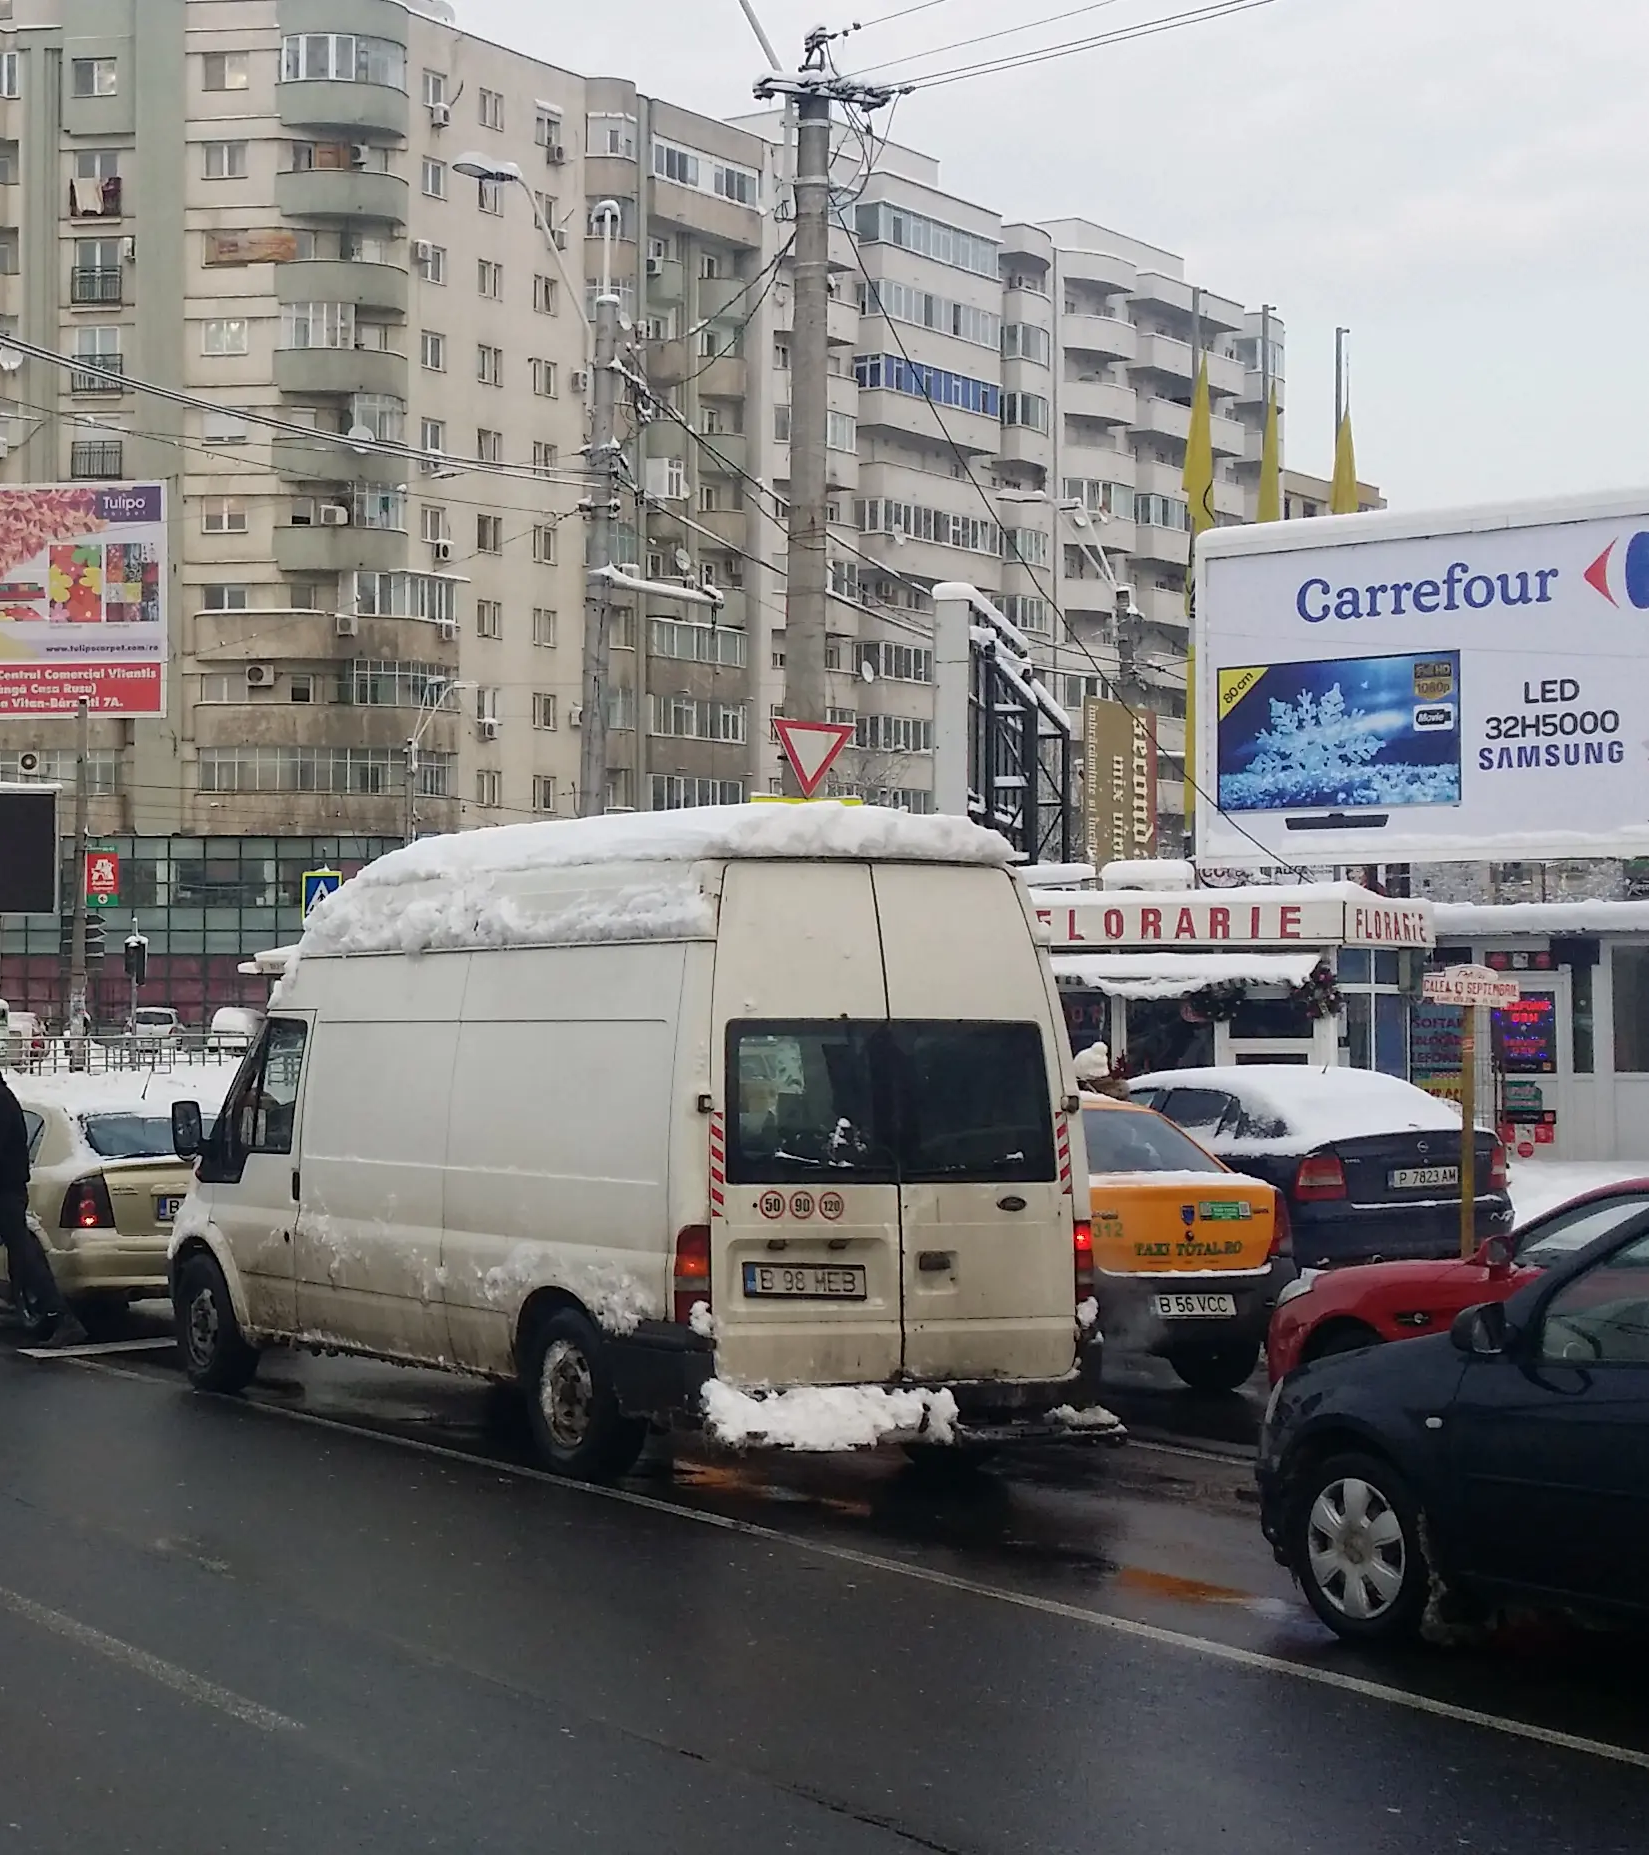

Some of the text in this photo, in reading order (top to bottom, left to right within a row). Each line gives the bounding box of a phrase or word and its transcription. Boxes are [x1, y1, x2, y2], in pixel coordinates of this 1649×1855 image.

[103, 494, 146, 511] Tulipo
[1296, 562, 1559, 623] Carrefour
[1222, 671, 1254, 705] 80 cm
[1524, 678, 1580, 704] LED
[1417, 712, 1445, 723] Movie
[1484, 709, 1621, 740] 32H5000
[1478, 740, 1625, 770] SAMSUNG
[1413, 1169, 1439, 1184] 7823
[764, 1198, 841, 1212] 50 90 120
[1134, 1243, 1170, 1256] TAXI
[760, 1269, 773, 1290] B
[784, 1270, 805, 1291] 98
[1159, 1296, 1228, 1313] B 56 VCC
